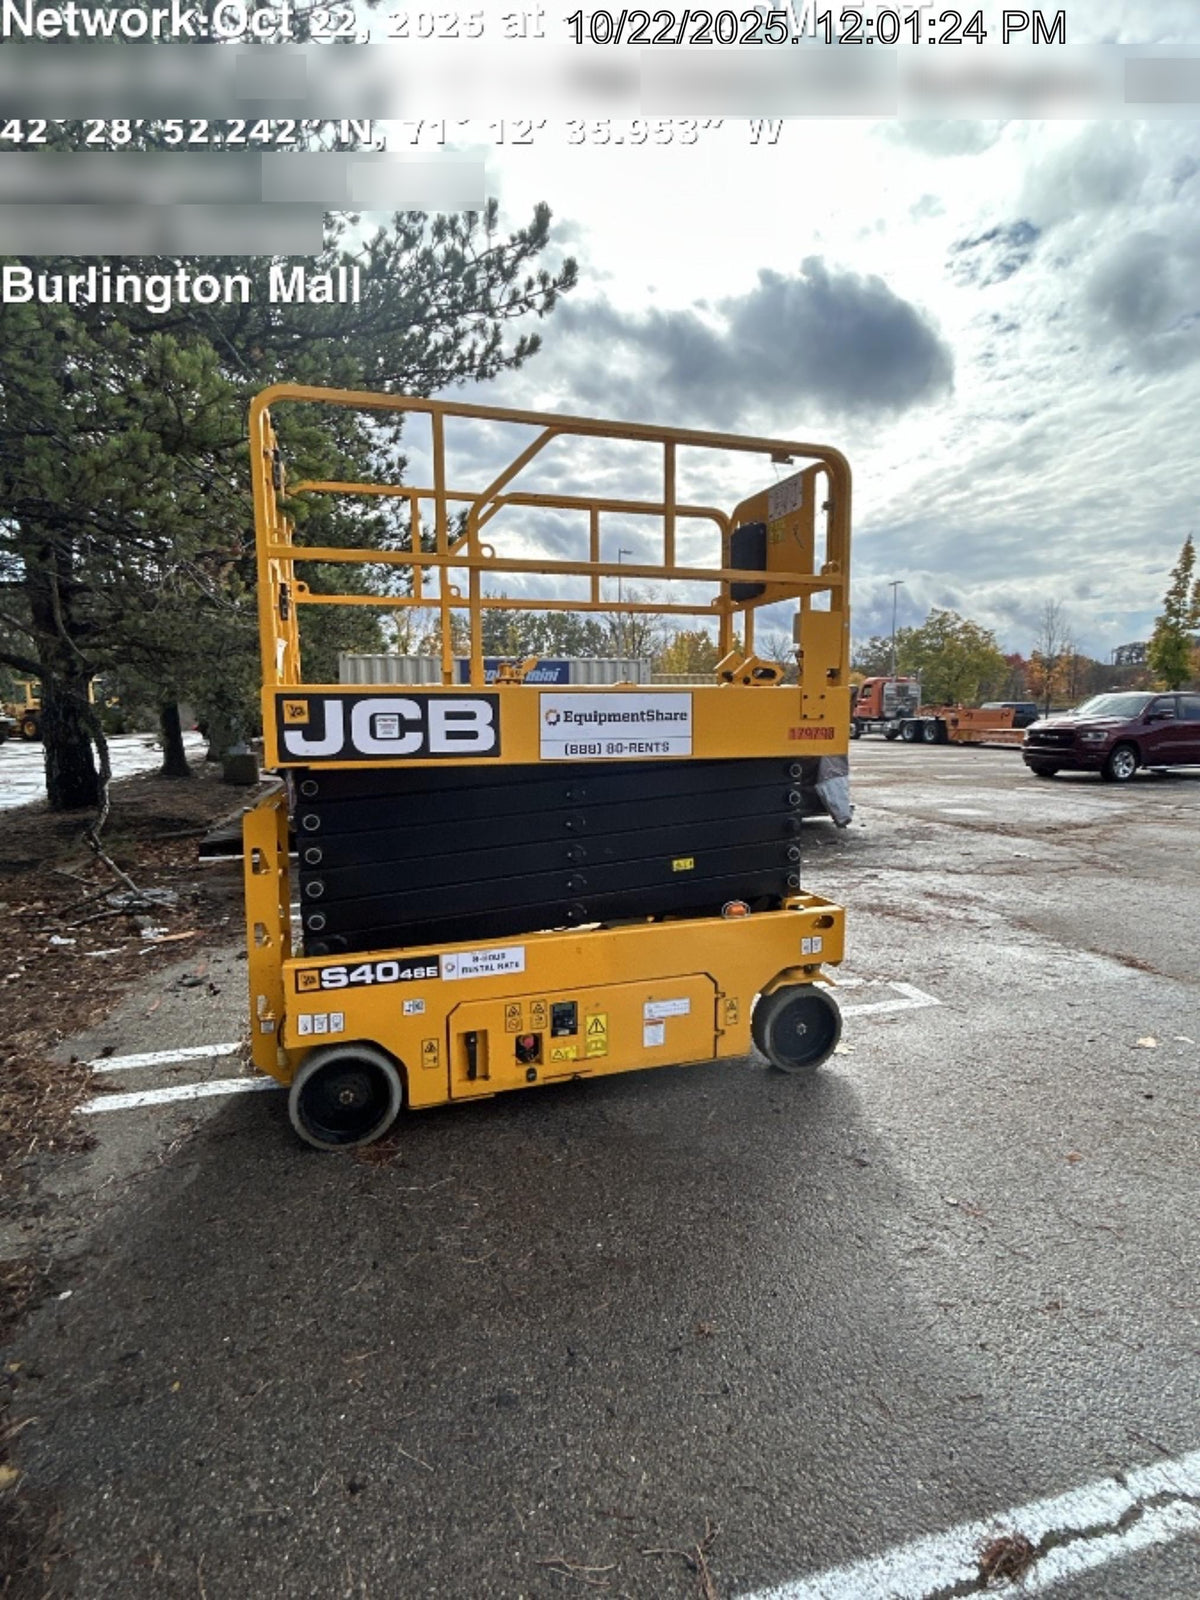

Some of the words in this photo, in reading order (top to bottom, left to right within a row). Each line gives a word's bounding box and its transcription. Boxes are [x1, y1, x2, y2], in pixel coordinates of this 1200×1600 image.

[563, 709, 688, 725] EquipmentShare
[283, 698, 495, 756] JCB
[564, 743, 602, 755] (888)
[606, 742, 670, 754] 80-RENTS
